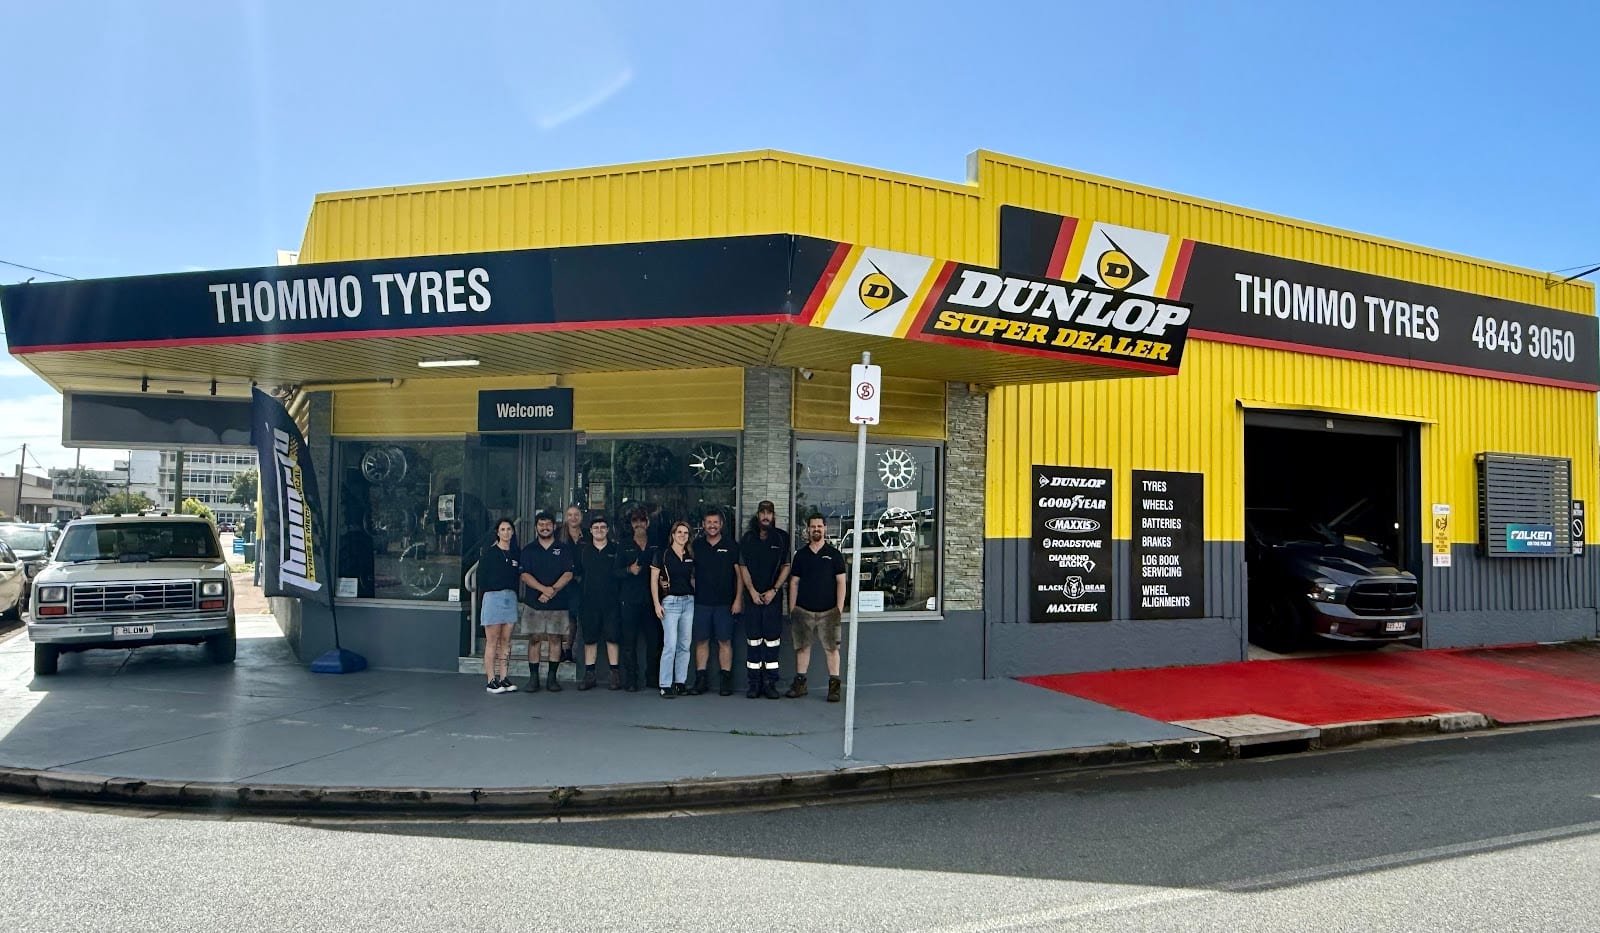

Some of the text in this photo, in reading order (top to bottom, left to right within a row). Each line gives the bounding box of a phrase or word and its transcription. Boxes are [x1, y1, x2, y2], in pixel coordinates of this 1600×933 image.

[208, 267, 492, 324] THOMMO TYRES
[947, 269, 1191, 336] DUNLOP
[1235, 273, 1575, 363] THOMMO TYRES 4843 3050
[934, 310, 1172, 361] SUPER DEALER
[496, 402, 554, 418] Welcome
[1050, 476, 1106, 488] DUNLOP
[1142, 480, 1167, 493] TYRES
[1038, 494, 1107, 512] GOODYEAR
[1142, 499, 1174, 511] WHEELS
[1053, 519, 1092, 531] MAXXIS
[1142, 517, 1182, 529] BATTERIES
[1052, 539, 1102, 549] ROADSTONE
[1142, 536, 1172, 548] BRAKES
[306, 546, 315, 580] TYRES
[1048, 554, 1090, 562] DIAMOND
[1142, 554, 1180, 566] LOG BOOK
[1142, 566, 1182, 578] SERVICING
[1038, 584, 1063, 592] BLACK
[1142, 584, 1169, 596] WHEEL
[1142, 596, 1191, 608] ALIGNMENTS
[1046, 603, 1098, 614] MAXTREK
